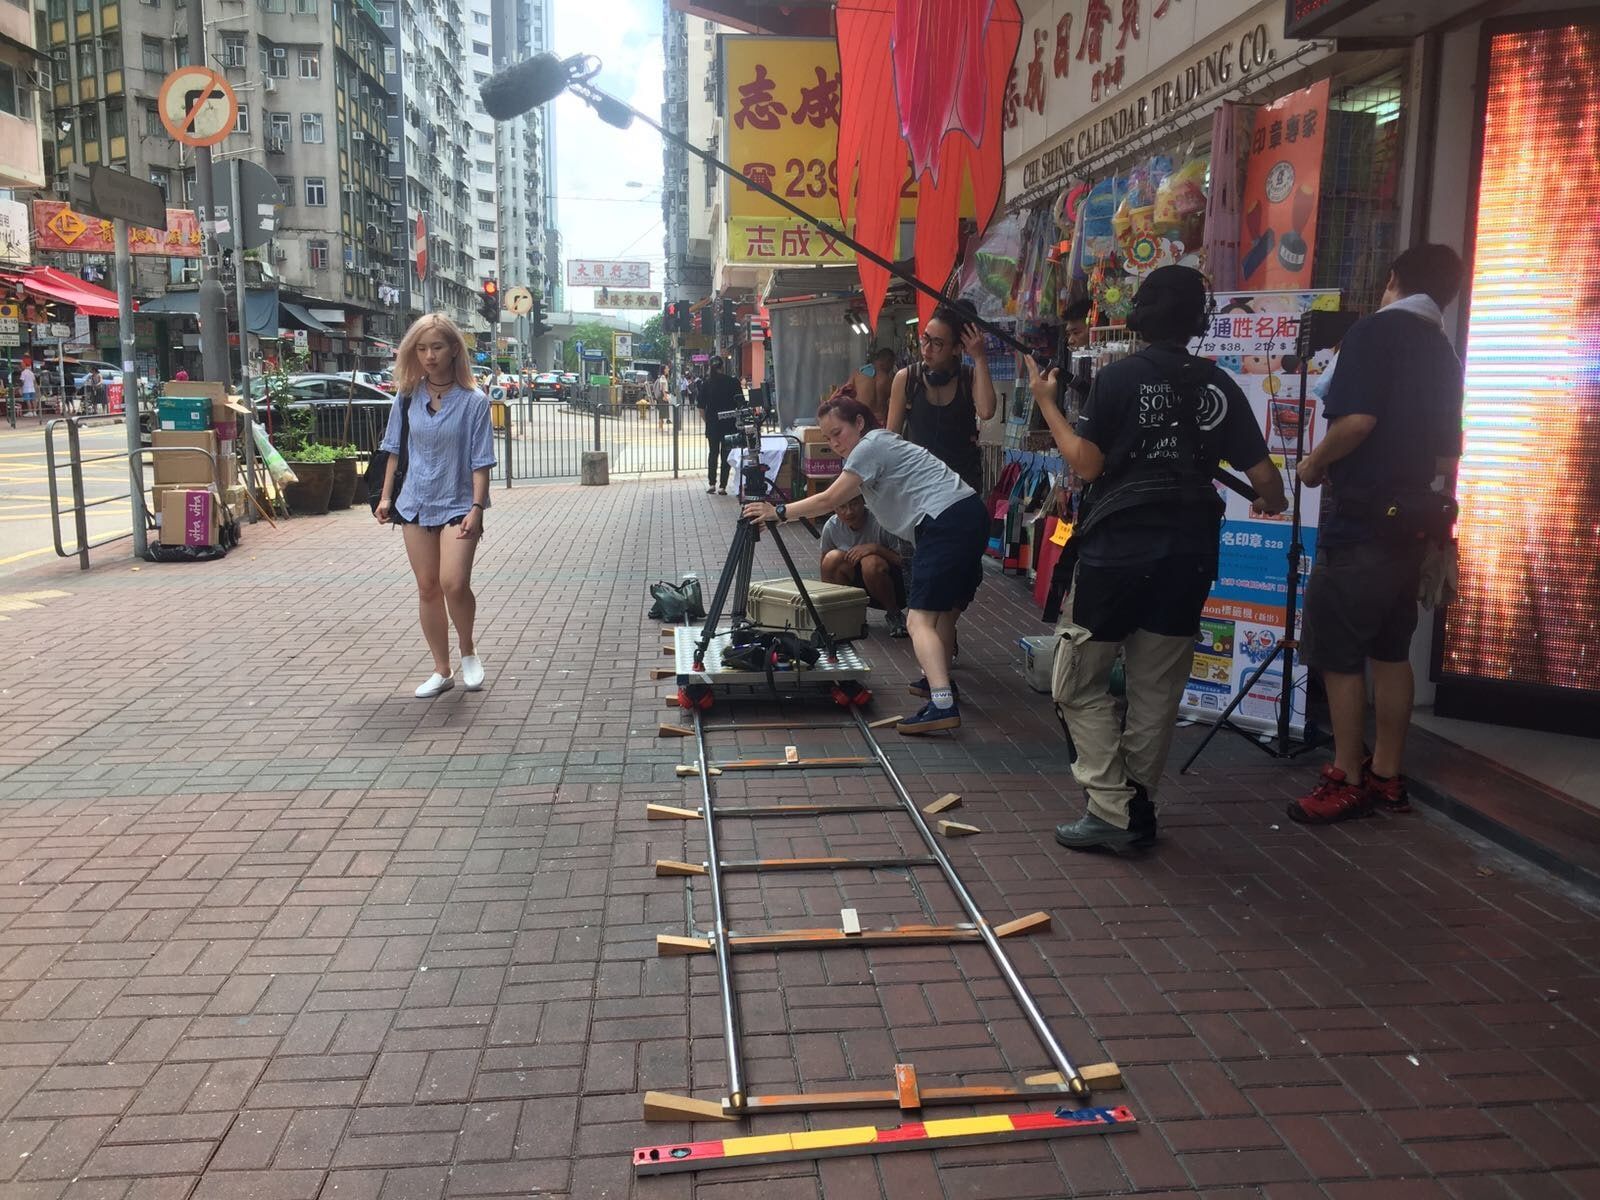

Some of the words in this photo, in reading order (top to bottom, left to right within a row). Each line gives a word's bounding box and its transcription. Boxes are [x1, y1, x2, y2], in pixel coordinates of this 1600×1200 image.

[1023, 162, 1040, 189] CHI
[1041, 142, 1075, 184] SHING
[1077, 97, 1150, 158] CALENDAR
[1151, 45, 1232, 125] TRADING
[1239, 23, 1276, 75] CO.
[1211, 315, 1298, 339] 通姓名貼
[1219, 531, 1262, 548] 名印章
